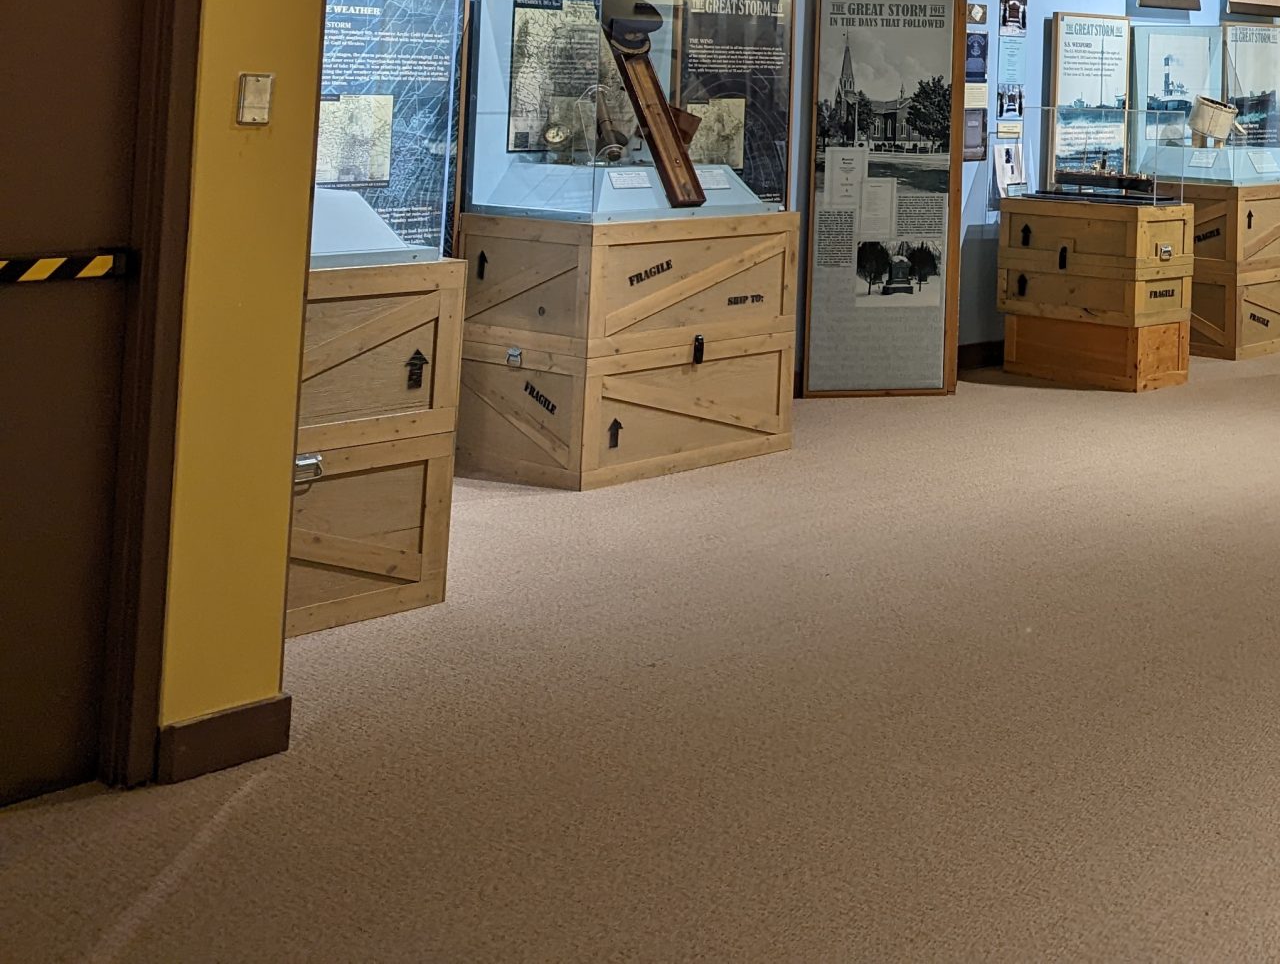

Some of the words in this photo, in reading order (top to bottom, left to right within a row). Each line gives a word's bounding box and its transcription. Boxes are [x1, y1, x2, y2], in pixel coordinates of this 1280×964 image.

[334, 5, 380, 15] WEATHER
[692, 0, 705, 9] THE
[738, 0, 771, 16] STORM
[831, 3, 844, 12] THE
[847, 2, 885, 16] GREAT
[888, 3, 927, 17] STORM
[930, 5, 945, 14] 1913
[326, 21, 351, 29] STORM
[829, 17, 838, 26] IN
[841, 17, 856, 27] THE
[858, 17, 878, 27] DAYS
[880, 18, 900, 27] THAT
[902, 19, 945, 29] FOLLOWED
[1065, 23, 1074, 31] THE
[1074, 22, 1095, 36] GREAT
[1095, 24, 1115, 37] STORM
[1239, 31, 1254, 43] GREAT
[628, 259, 672, 287] FRAGILE
[727, 296, 748, 306] SHIP
[750, 294, 764, 303] TO:
[1149, 289, 1175, 299] FRAGILE
[1249, 312, 1270, 328] FRAGILE
[524, 380, 557, 416] FRAGILE
